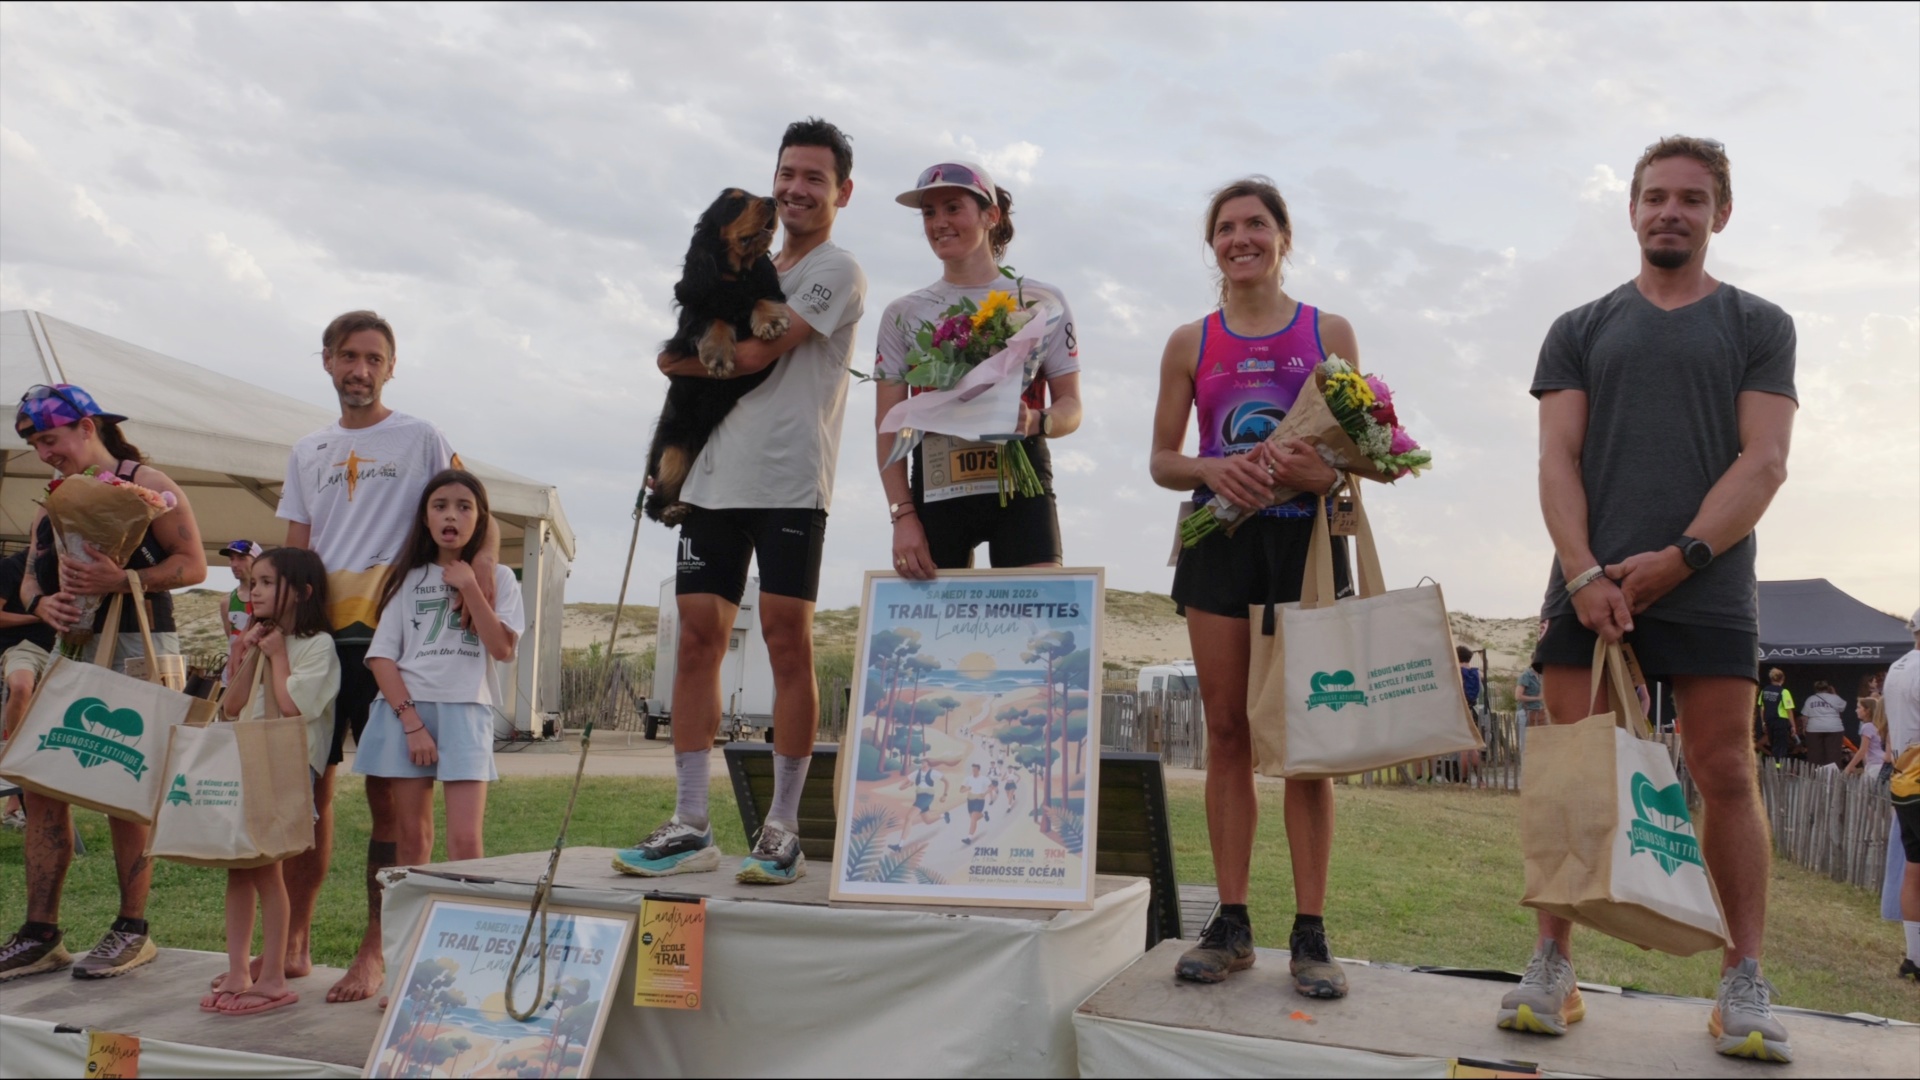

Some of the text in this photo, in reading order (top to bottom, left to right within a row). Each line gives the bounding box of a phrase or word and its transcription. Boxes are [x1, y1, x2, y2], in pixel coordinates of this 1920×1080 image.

[811, 283, 832, 301] RD
[802, 293, 830, 311] CYCLES
[956, 450, 998, 472] 1073
[415, 585, 437, 594] TRUE
[926, 589, 1039, 600] SAMEDI 20 JUIN 2026
[888, 602, 1080, 620] TRAIL DES MOUETTES
[415, 648, 437, 660] from
[457, 648, 480, 658] heart
[1768, 646, 1885, 657] AQUASPORT
[1370, 666, 1392, 678] RÉDUIS
[1392, 663, 1406, 673] MES
[1406, 658, 1433, 670] DÉCHETS
[1374, 677, 1400, 690] RECYCLE
[1405, 670, 1435, 682] RÉUTILISE
[1379, 686, 1417, 701] CONSOMME
[1418, 682, 1439, 693] LOCAL
[51, 731, 140, 767] SEIGNOSSE ATTITUDE
[974, 847, 999, 857] 21KM
[1009, 848, 1035, 858] 13KM
[969, 864, 1066, 878] SEIGNOSSE OCÉAN
[643, 900, 704, 929] Landirun
[474, 920, 511, 933] SAMEDI
[511, 924, 523, 935] 20
[438, 931, 480, 952] TRAIL
[484, 937, 517, 956] DES
[660, 943, 686, 952] ECOLE
[655, 953, 690, 966] TRAIL
